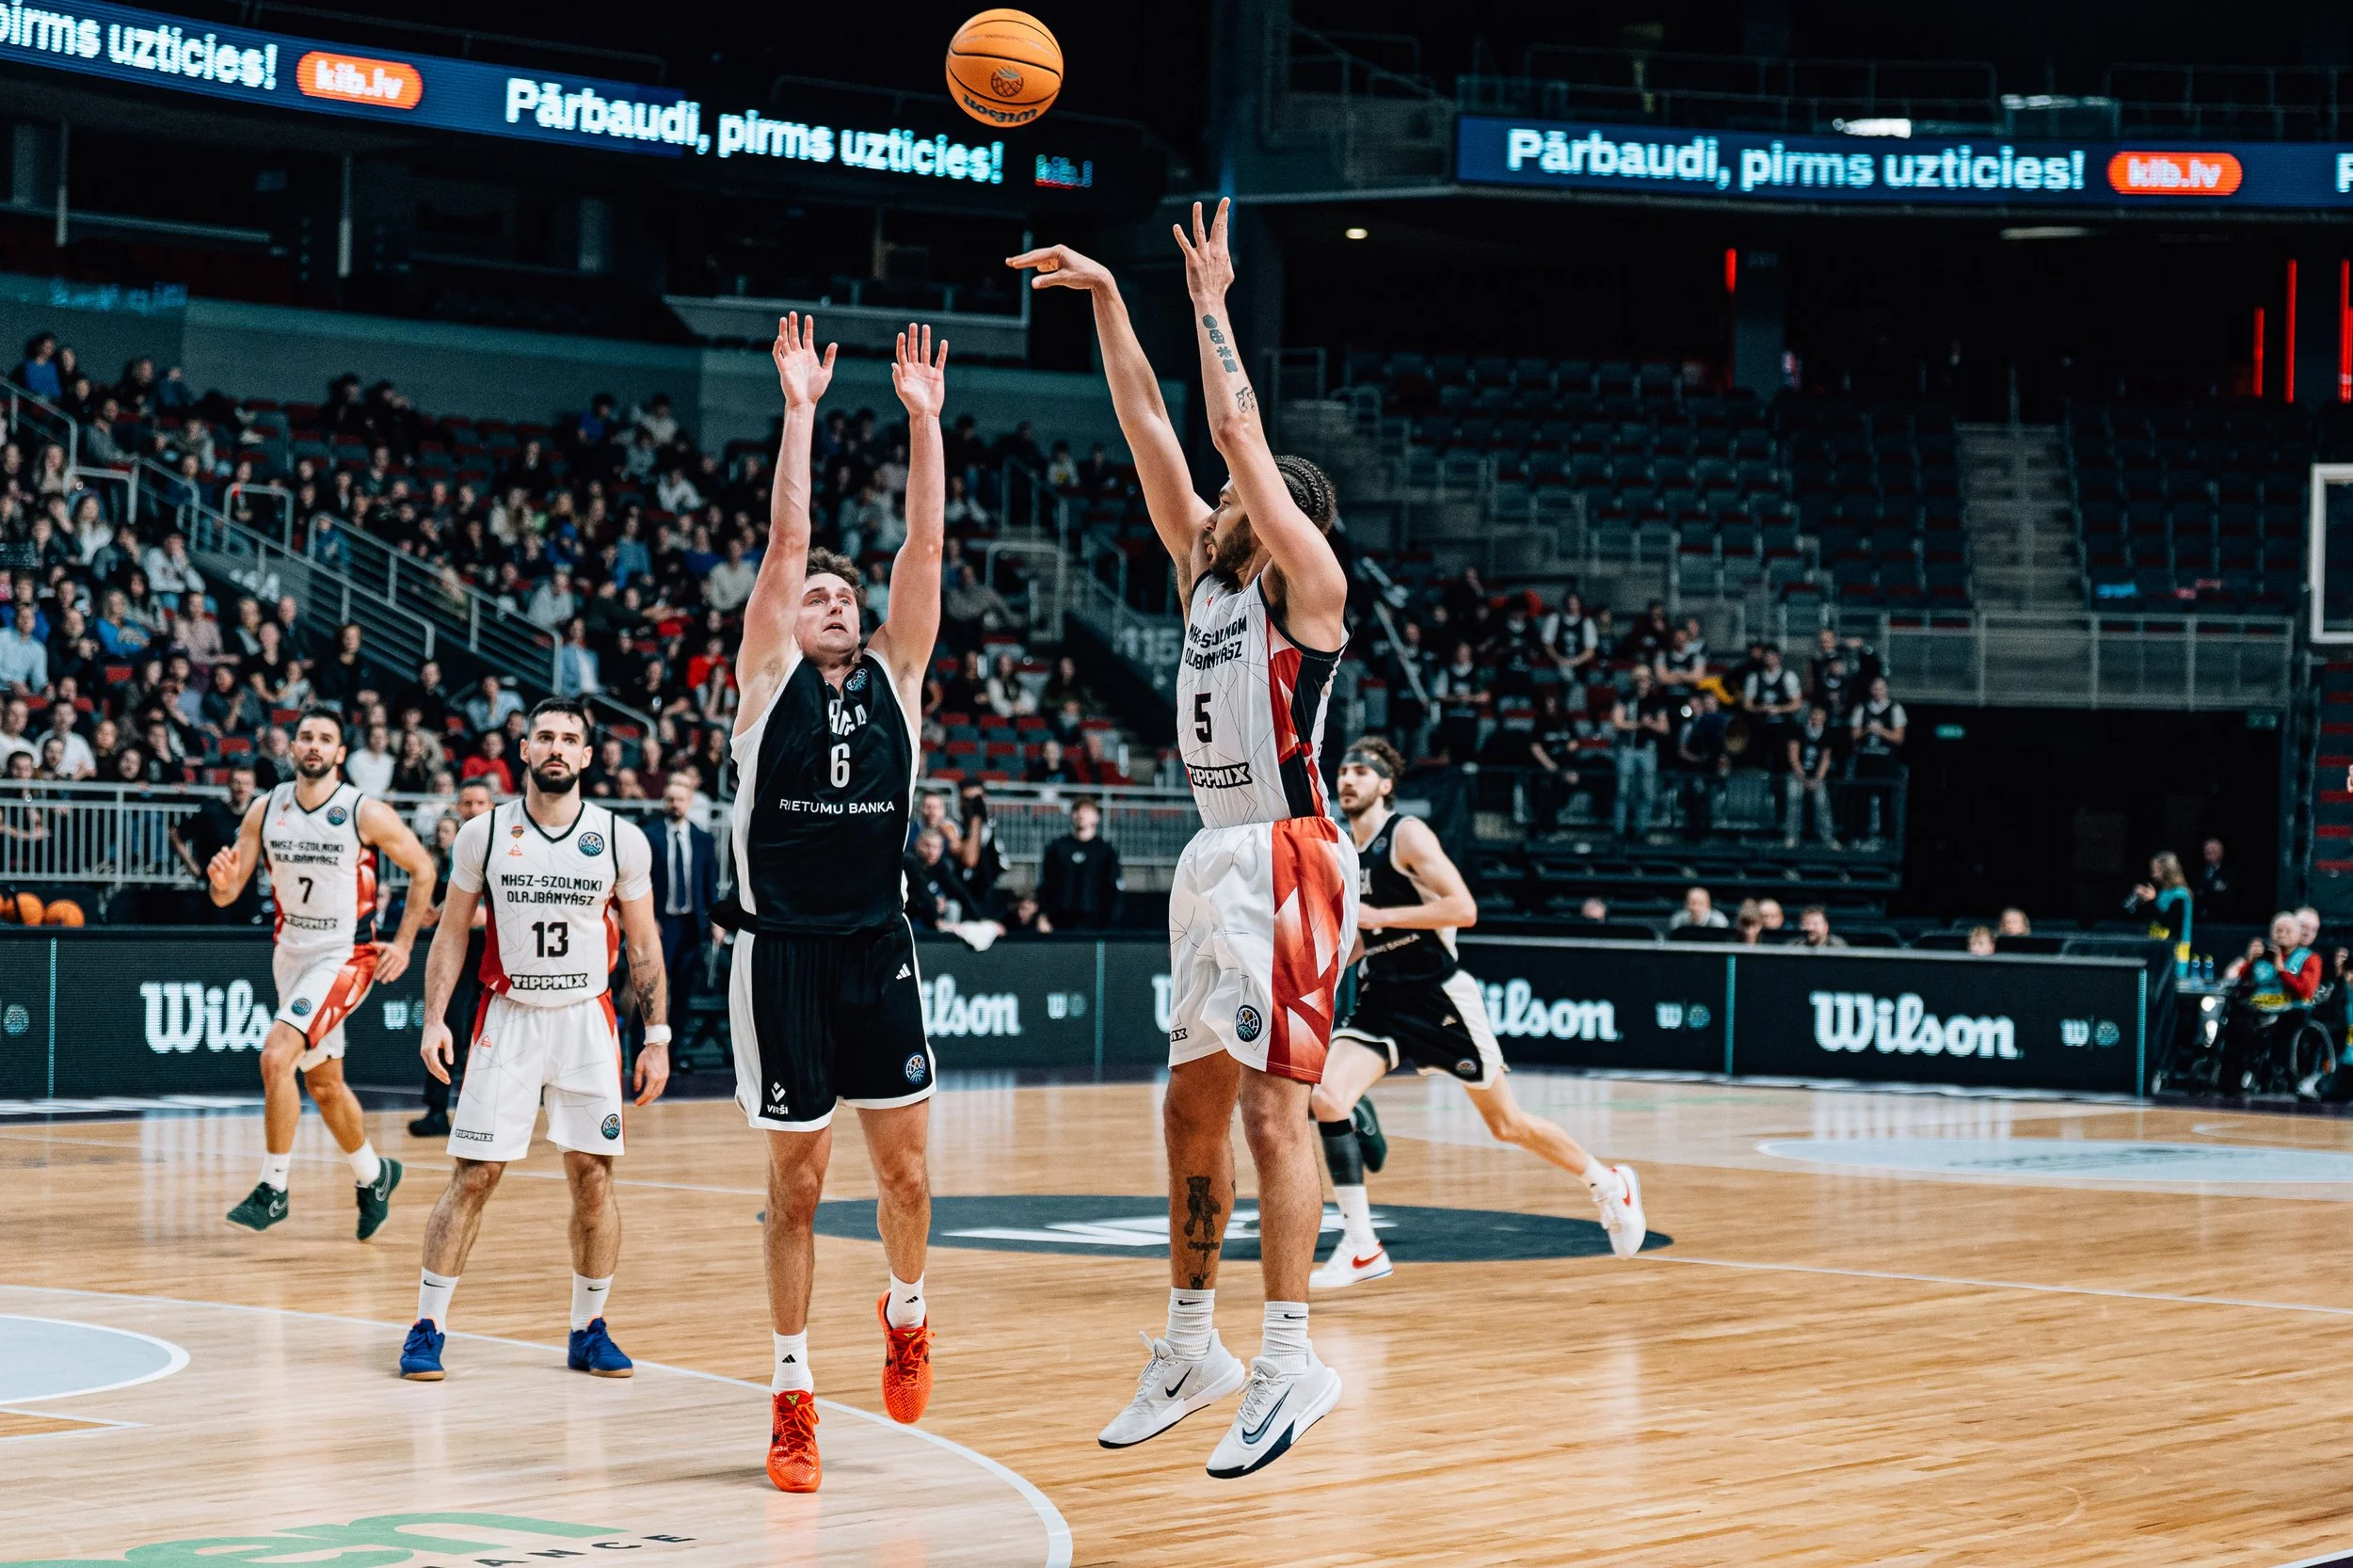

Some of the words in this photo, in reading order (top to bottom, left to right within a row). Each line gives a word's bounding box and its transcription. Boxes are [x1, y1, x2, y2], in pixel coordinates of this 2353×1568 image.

[108, 24, 278, 90] uzticies!
[315, 59, 405, 100] kib.lv
[506, 77, 711, 155] Pārbaudi,
[718, 108, 835, 163] pirms
[840, 127, 1004, 184] uzticies!
[1507, 128, 1731, 190] Pārbaudi,
[1739, 139, 1875, 192] pirms
[1883, 144, 2086, 192] uzticies!
[2127, 157, 2222, 189] kib.lv
[1194, 693, 1212, 743] 5
[830, 743, 851, 788] 6
[780, 798, 843, 814] RIETUMU
[849, 801, 895, 814] BANKA
[298, 876, 313, 904] 7
[532, 921, 568, 958] 13
[139, 979, 280, 1054] Wils
[921, 974, 1022, 1037] ilson
[1476, 978, 1619, 1042] ilson
[1809, 991, 2019, 1060] Wilson
[767, 1103, 789, 1115] VIRŠI
[421, 1534, 698, 1568] ANCE
